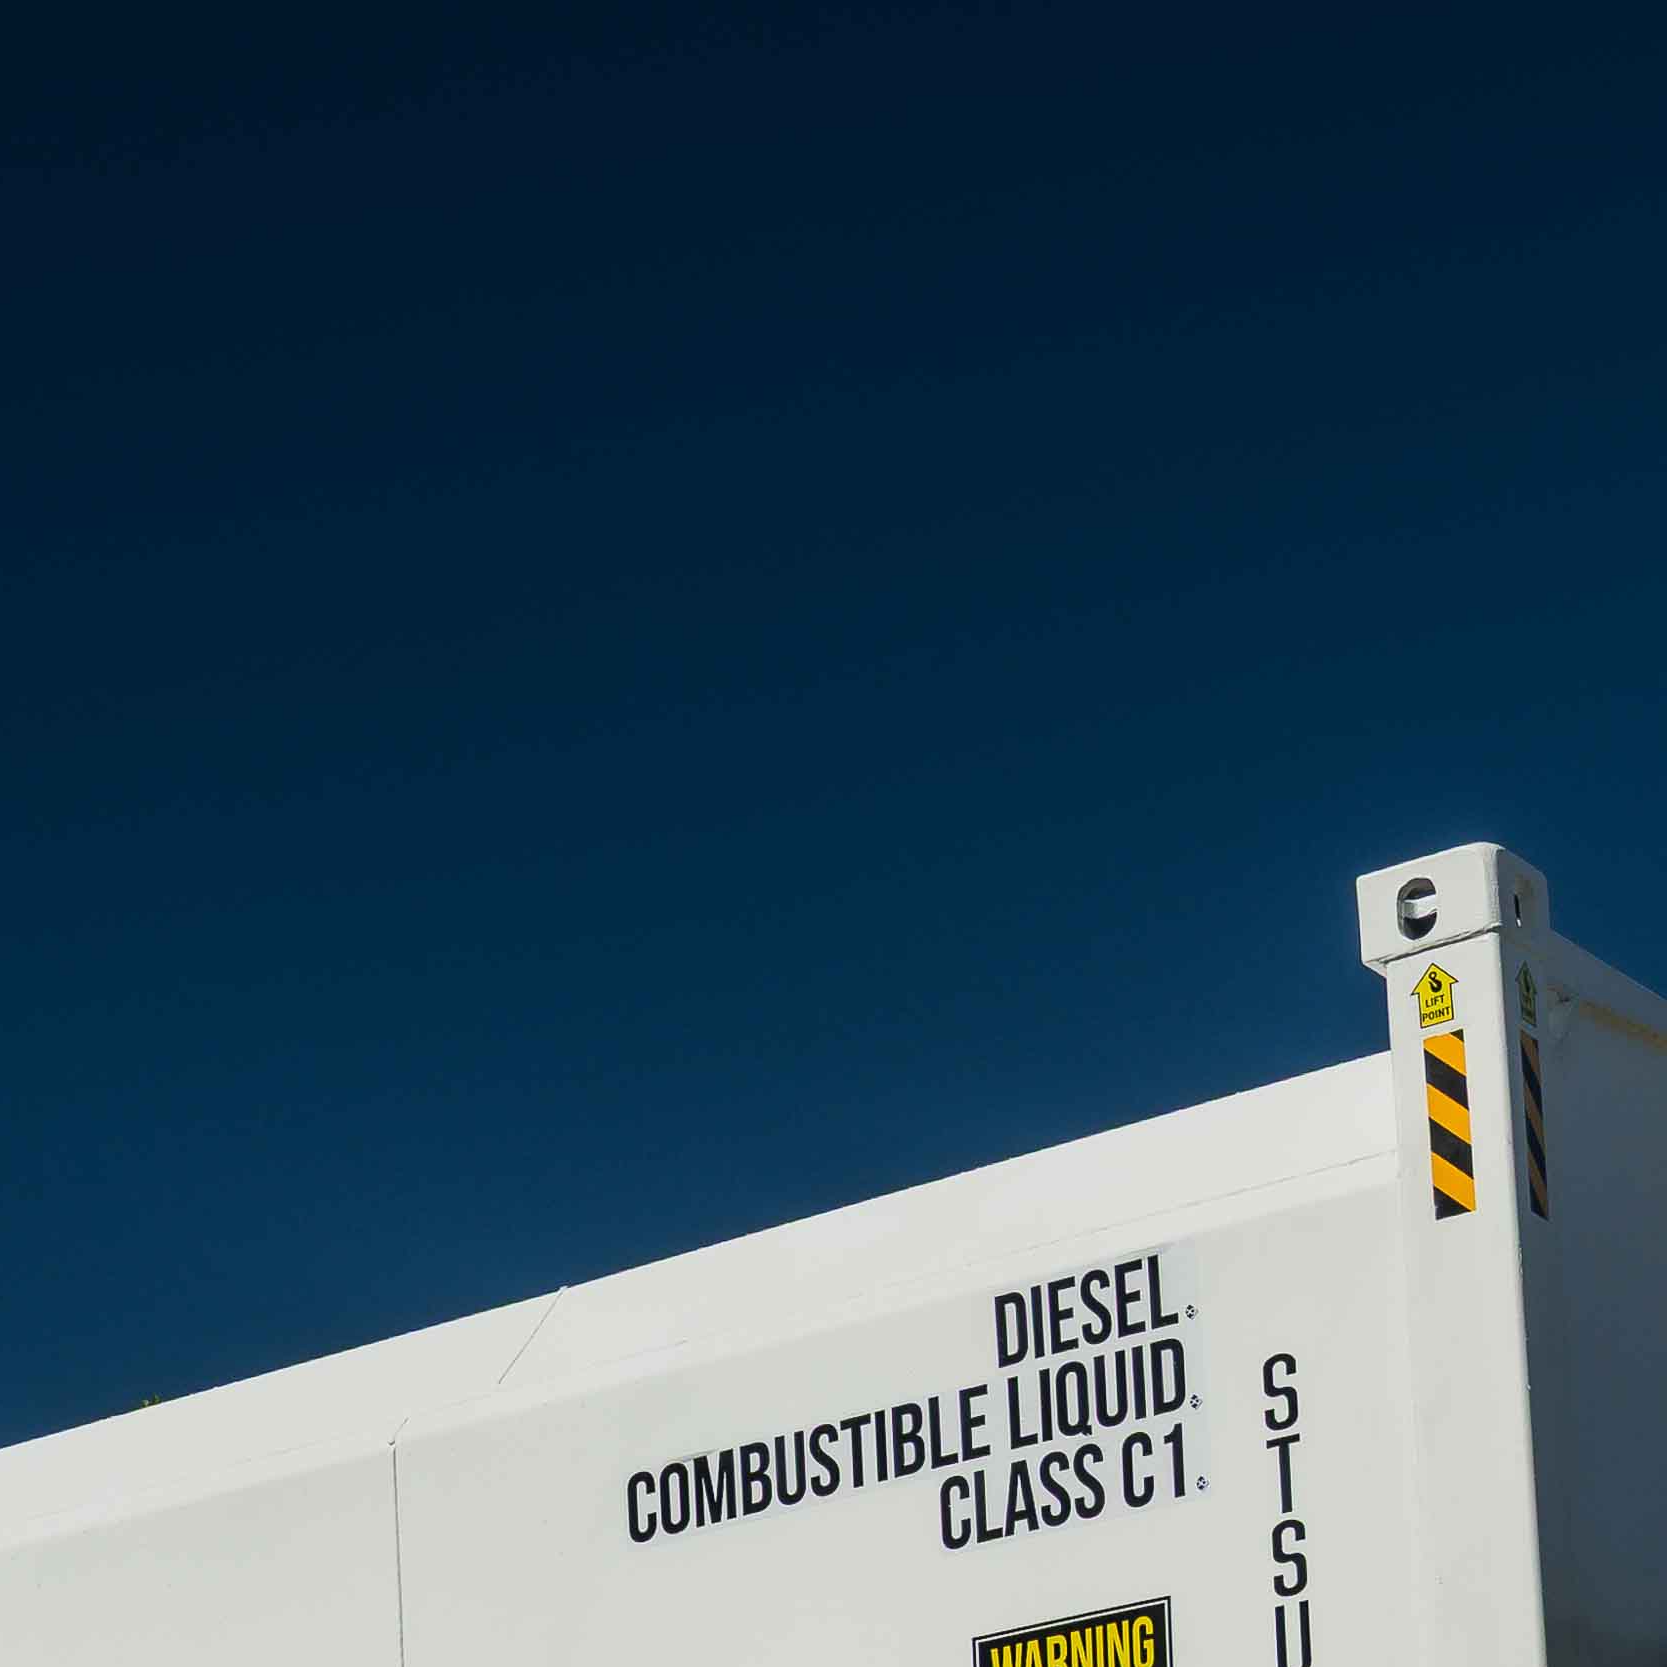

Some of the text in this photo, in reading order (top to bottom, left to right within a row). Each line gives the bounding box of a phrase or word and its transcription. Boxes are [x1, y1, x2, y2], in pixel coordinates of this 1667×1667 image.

[1422, 1007, 1451, 1023] POINT
[1425, 994, 1445, 1008] LIFT
[994, 1254, 1179, 1368] DIESEL
[626, 1337, 1186, 1544] COMBUSTIBLE LIQUID
[939, 1422, 1186, 1550] CLASS C1
